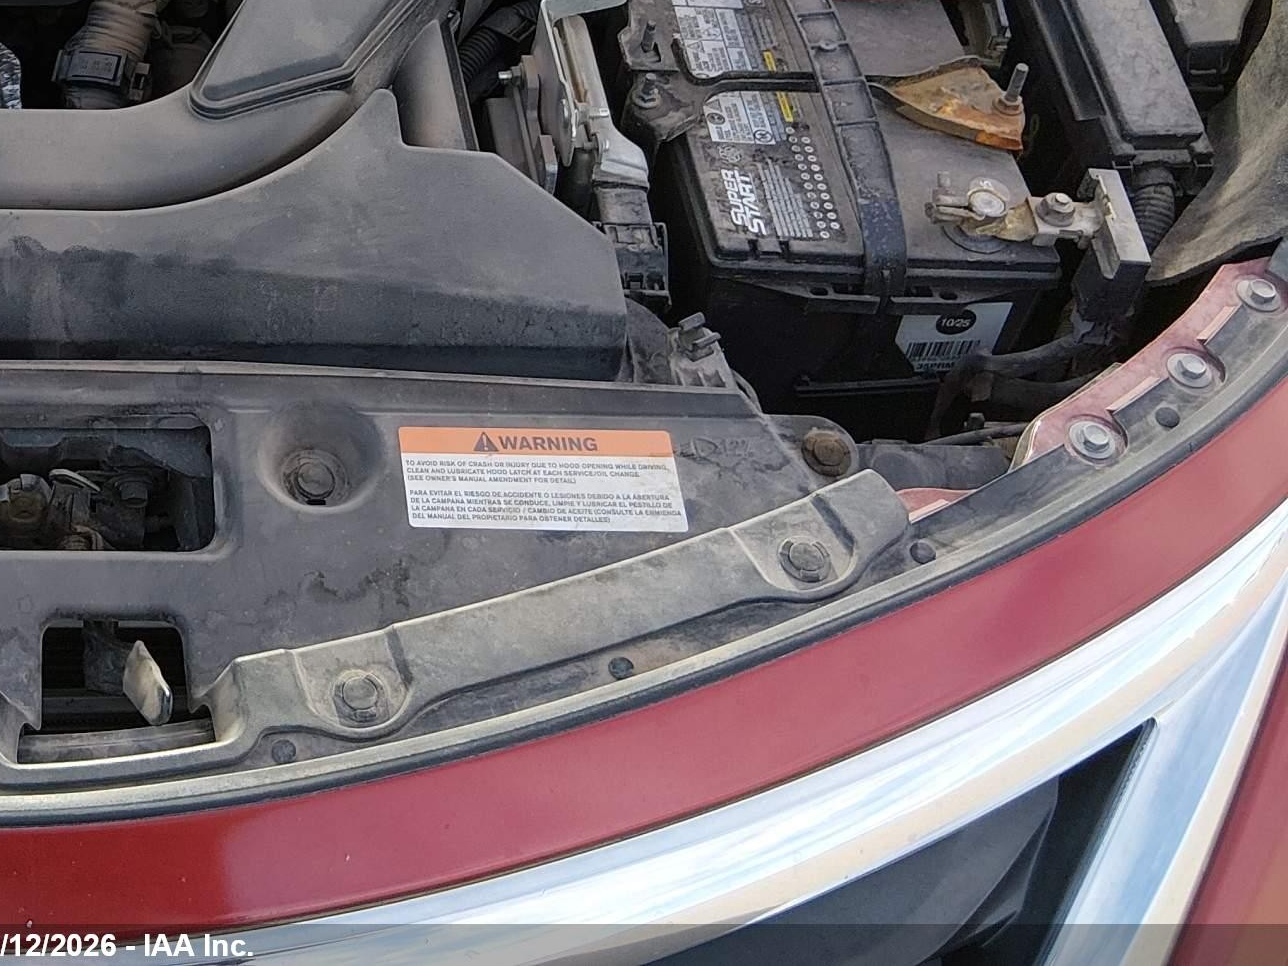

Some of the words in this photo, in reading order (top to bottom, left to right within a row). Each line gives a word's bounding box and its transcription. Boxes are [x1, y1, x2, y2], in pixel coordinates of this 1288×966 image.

[720, 169, 743, 225] SUPER
[734, 169, 767, 235] START
[940, 318, 971, 328] 10/25
[498, 436, 598, 451] WARNING
